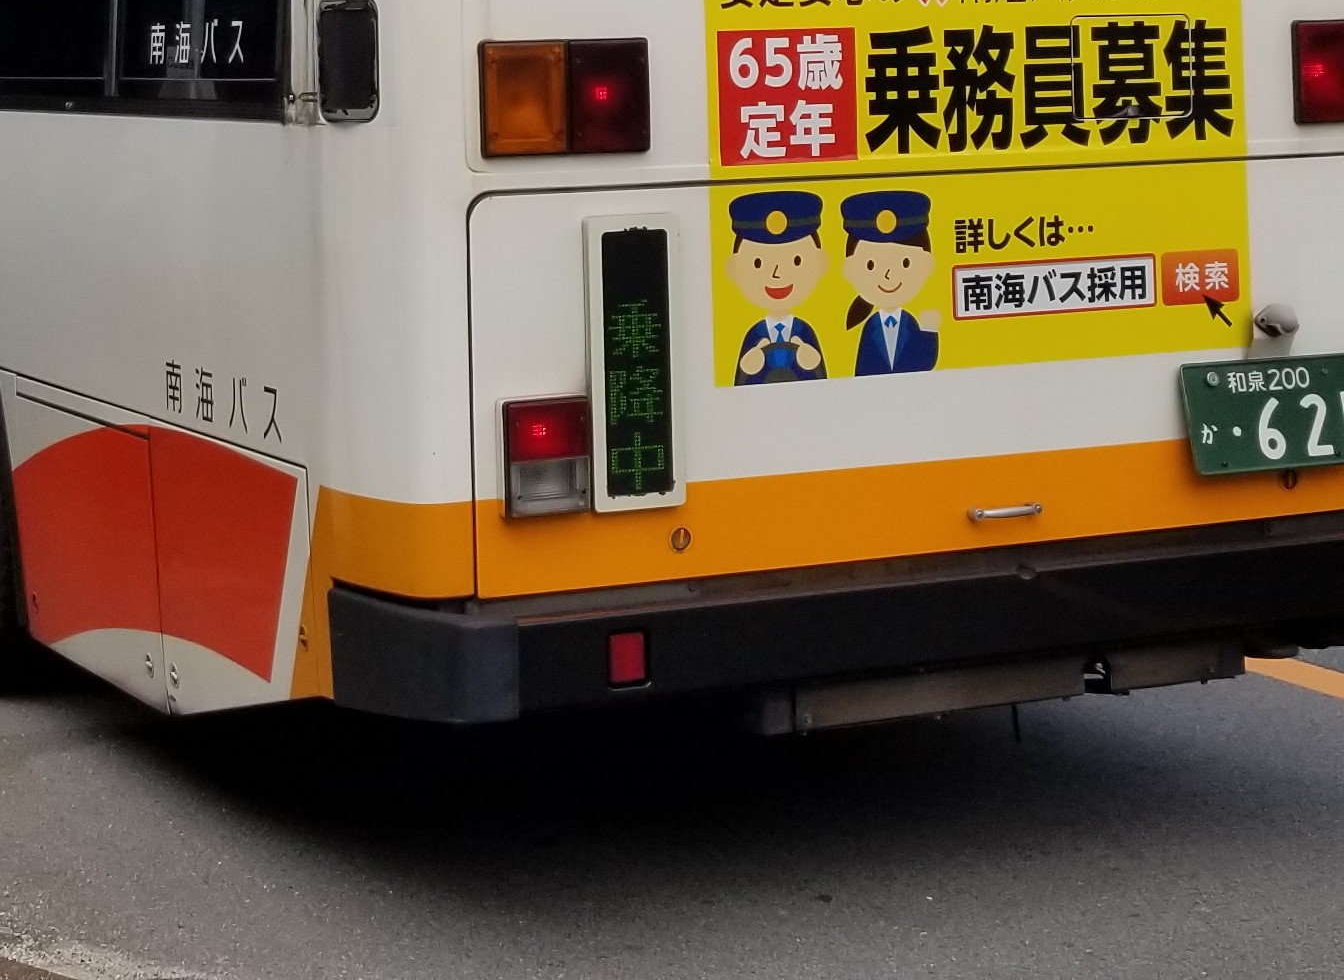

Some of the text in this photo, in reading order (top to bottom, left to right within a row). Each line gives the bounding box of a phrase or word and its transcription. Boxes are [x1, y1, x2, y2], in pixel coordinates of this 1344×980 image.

[150, 18, 244, 64] 南海バス
[728, 33, 844, 93] 65歳
[864, 18, 1235, 154] 乗務員募集
[739, 99, 836, 160] 定年
[961, 260, 1230, 311] 南海バス採用 検索
[165, 359, 283, 445] 南海バス
[608, 299, 665, 492] 乗降中
